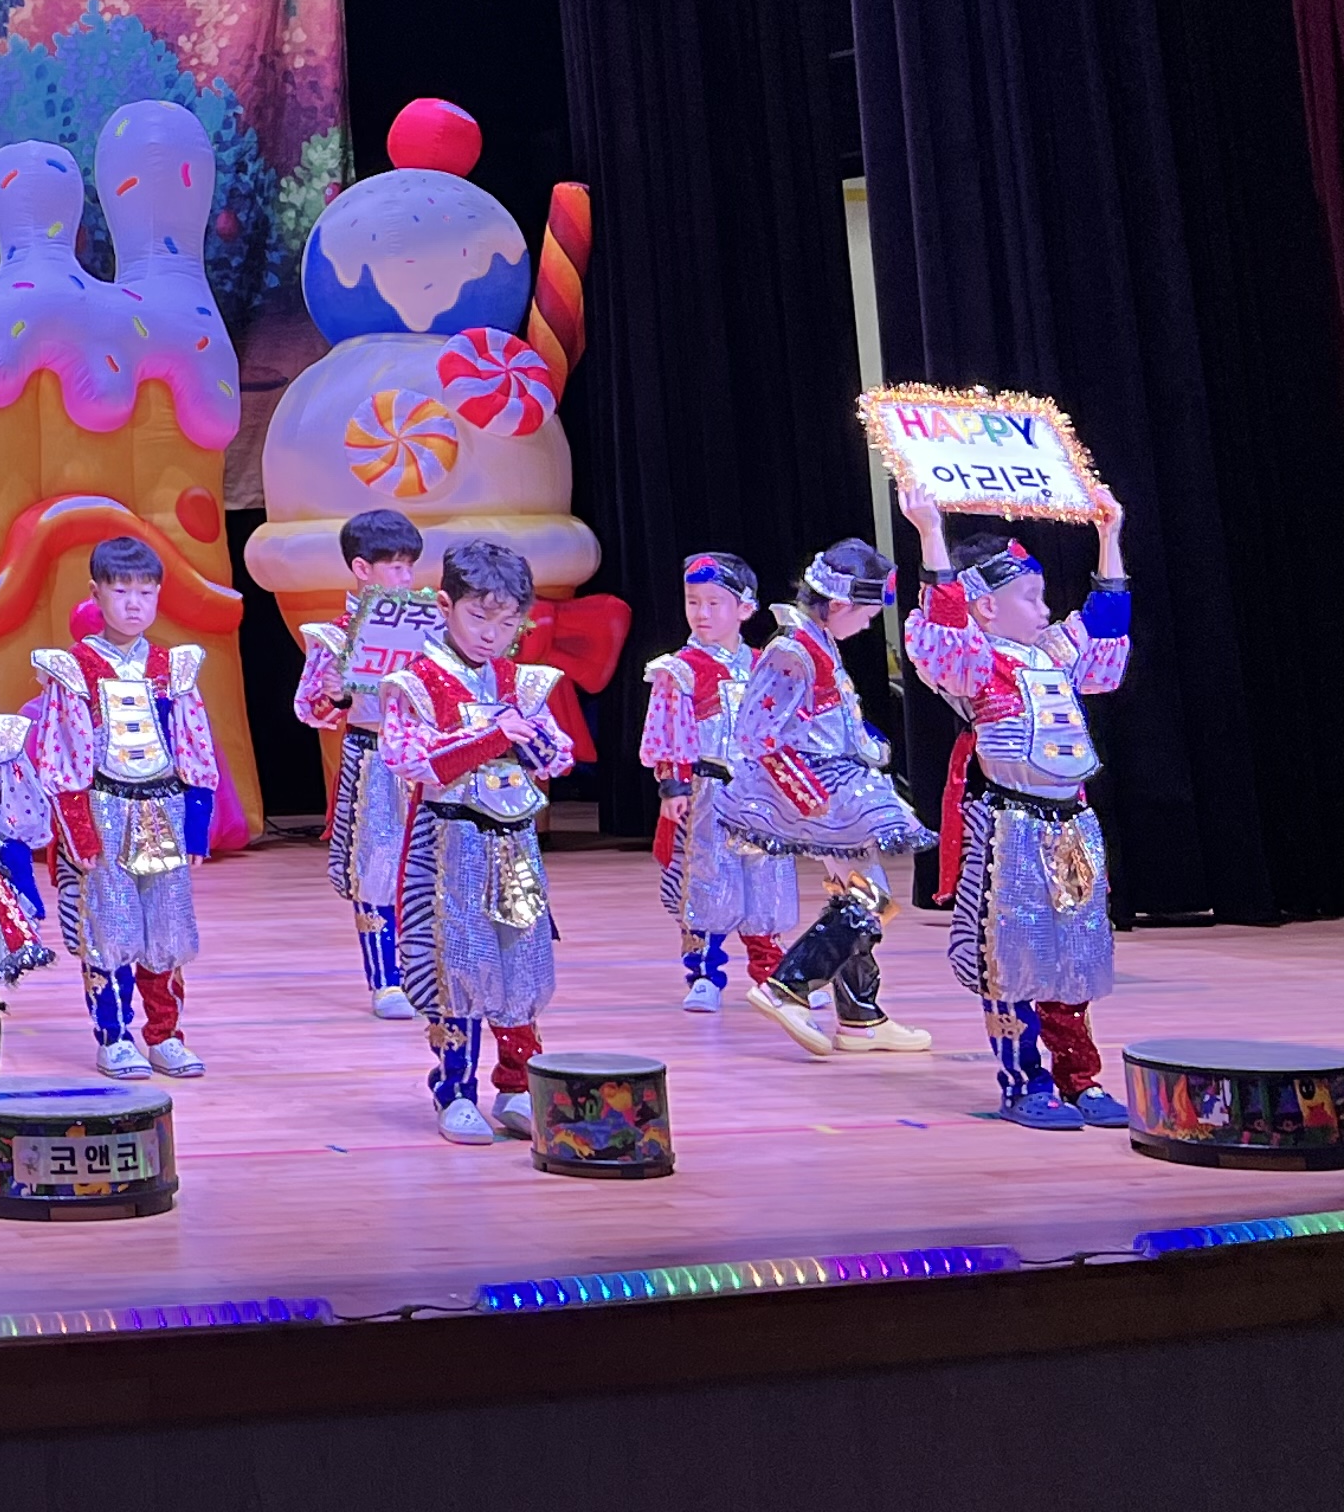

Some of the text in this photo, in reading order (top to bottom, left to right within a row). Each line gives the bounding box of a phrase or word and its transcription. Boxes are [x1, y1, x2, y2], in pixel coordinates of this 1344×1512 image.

[894, 407, 1036, 447] HAPPY
[931, 463, 1053, 498] 아리랑
[369, 598, 446, 631] 와주
[49, 1142, 140, 1176] 코앤코
